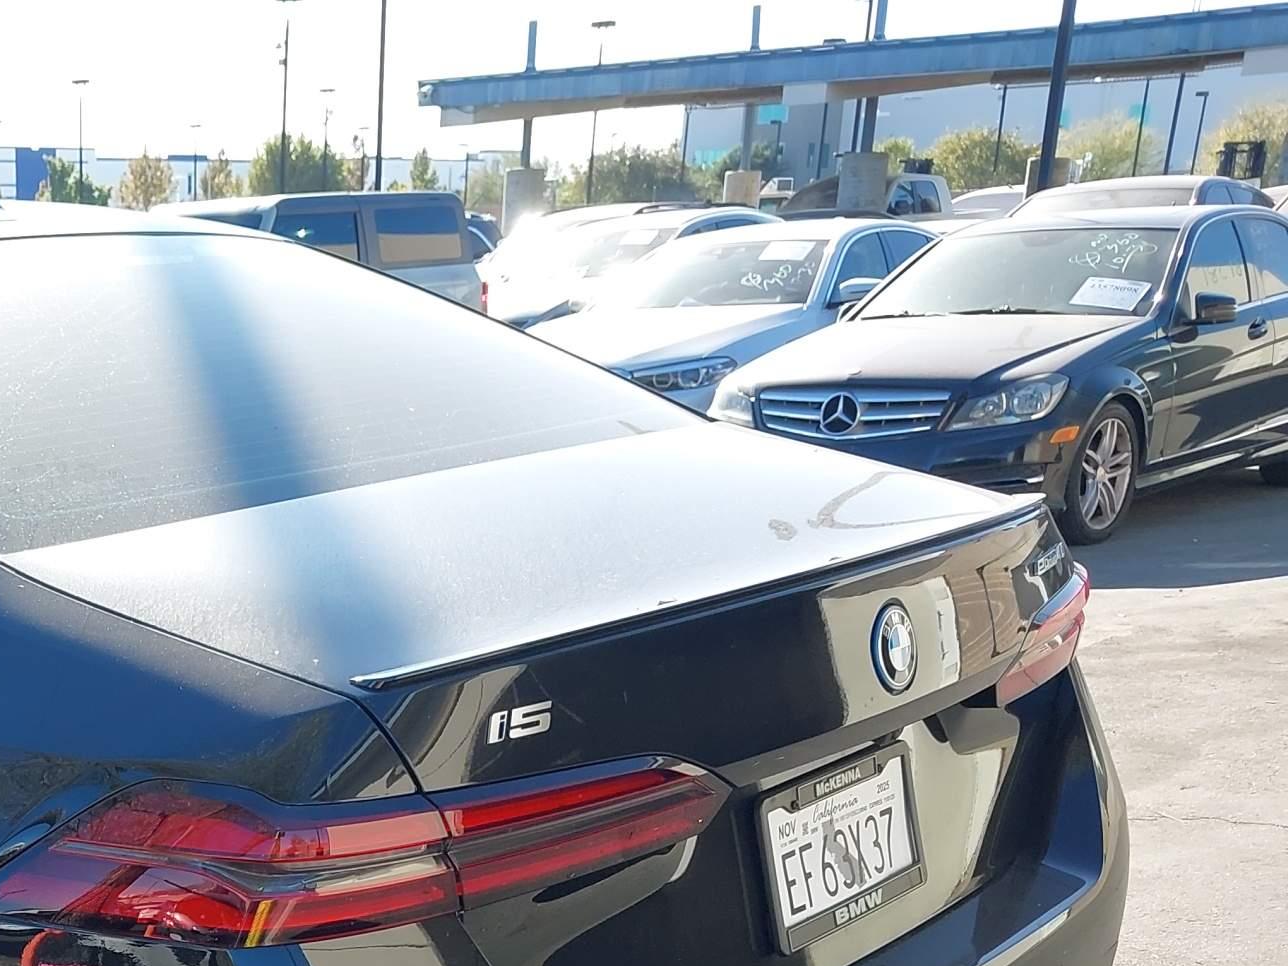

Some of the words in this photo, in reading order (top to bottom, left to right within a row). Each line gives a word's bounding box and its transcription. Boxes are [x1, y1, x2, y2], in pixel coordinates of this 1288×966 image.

[487, 700, 553, 745] i5
[814, 767, 862, 798] McKENNA
[778, 818, 797, 841] NOV
[812, 793, 859, 824] California
[834, 888, 883, 926] BMW
